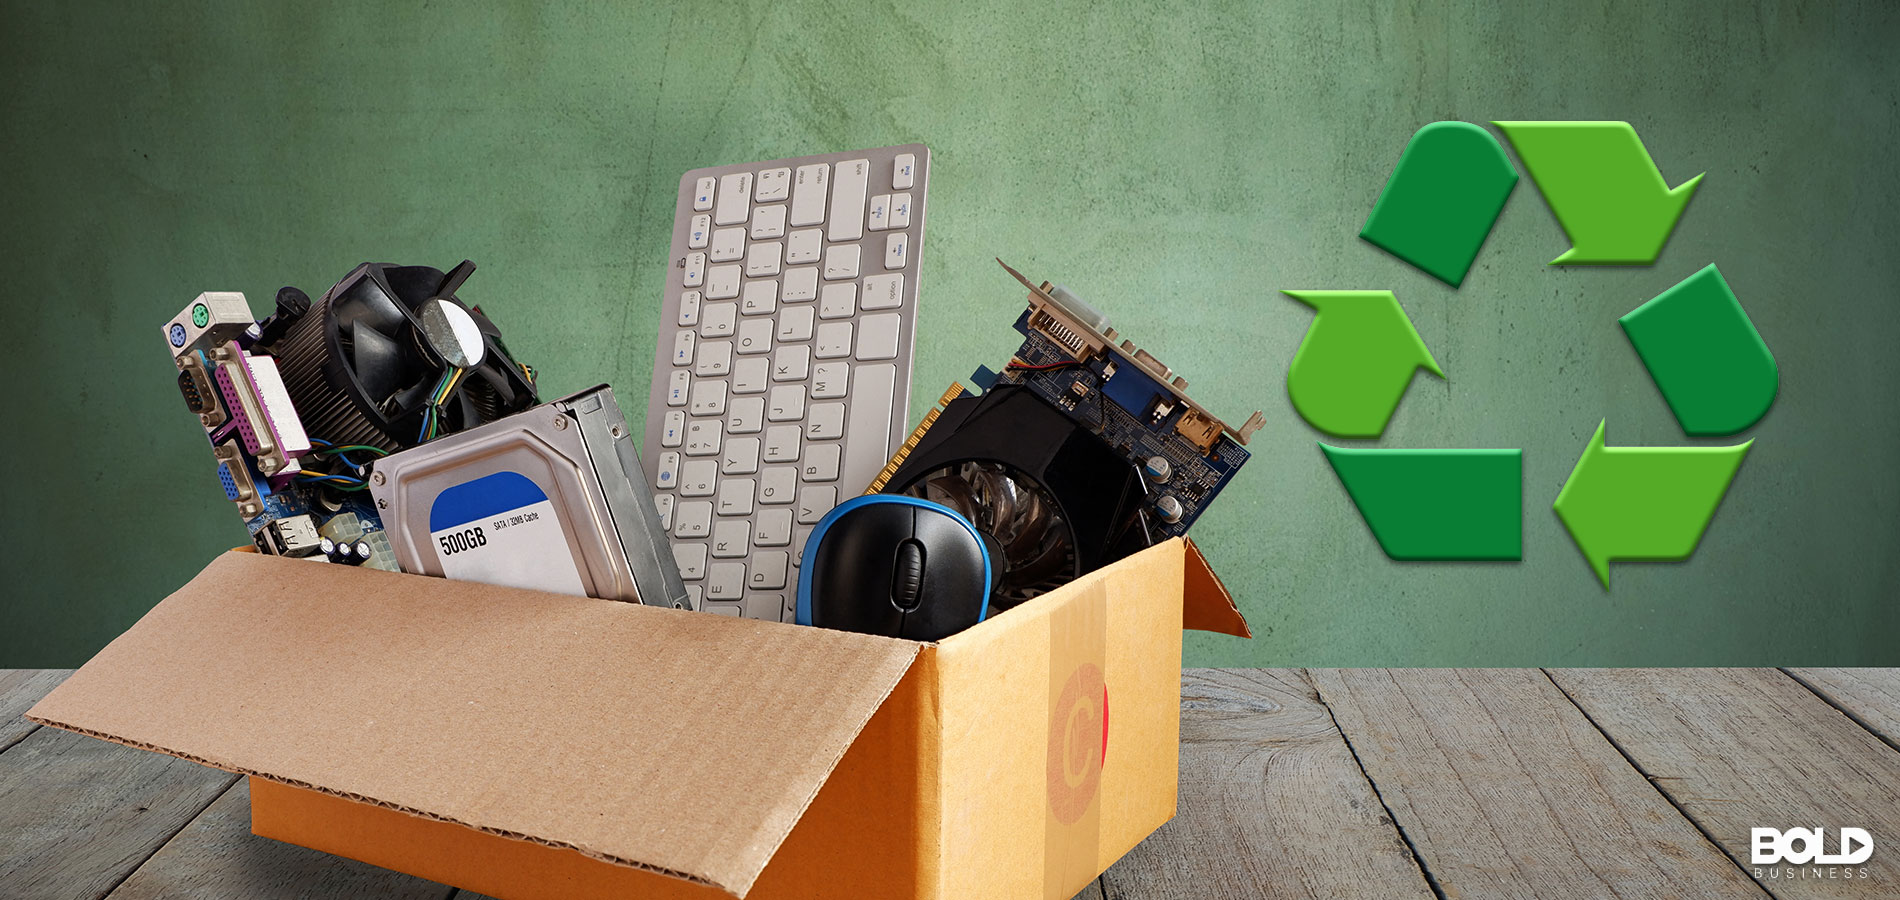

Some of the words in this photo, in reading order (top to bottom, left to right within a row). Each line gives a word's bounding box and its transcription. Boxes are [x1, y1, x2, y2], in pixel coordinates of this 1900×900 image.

[746, 300, 756, 308] P
[778, 366, 788, 374] K
[815, 382, 826, 392] M
[732, 418, 742, 427] U
[811, 424, 822, 432] N
[768, 446, 779, 456] H
[727, 458, 738, 467] Y
[806, 466, 816, 475] B
[764, 487, 774, 497] G
[663, 498, 669, 506] F5
[722, 500, 732, 508] T
[802, 508, 812, 517] V
[494, 520, 508, 530] SATA
[510, 515, 524, 527] 32MB
[524, 512, 539, 523] Cache
[678, 522, 686, 531] %
[439, 526, 487, 556] 500GB
[716, 541, 728, 551] R
[754, 573, 764, 582] D
[712, 586, 722, 594] E
[1063, 695, 1095, 789] C
